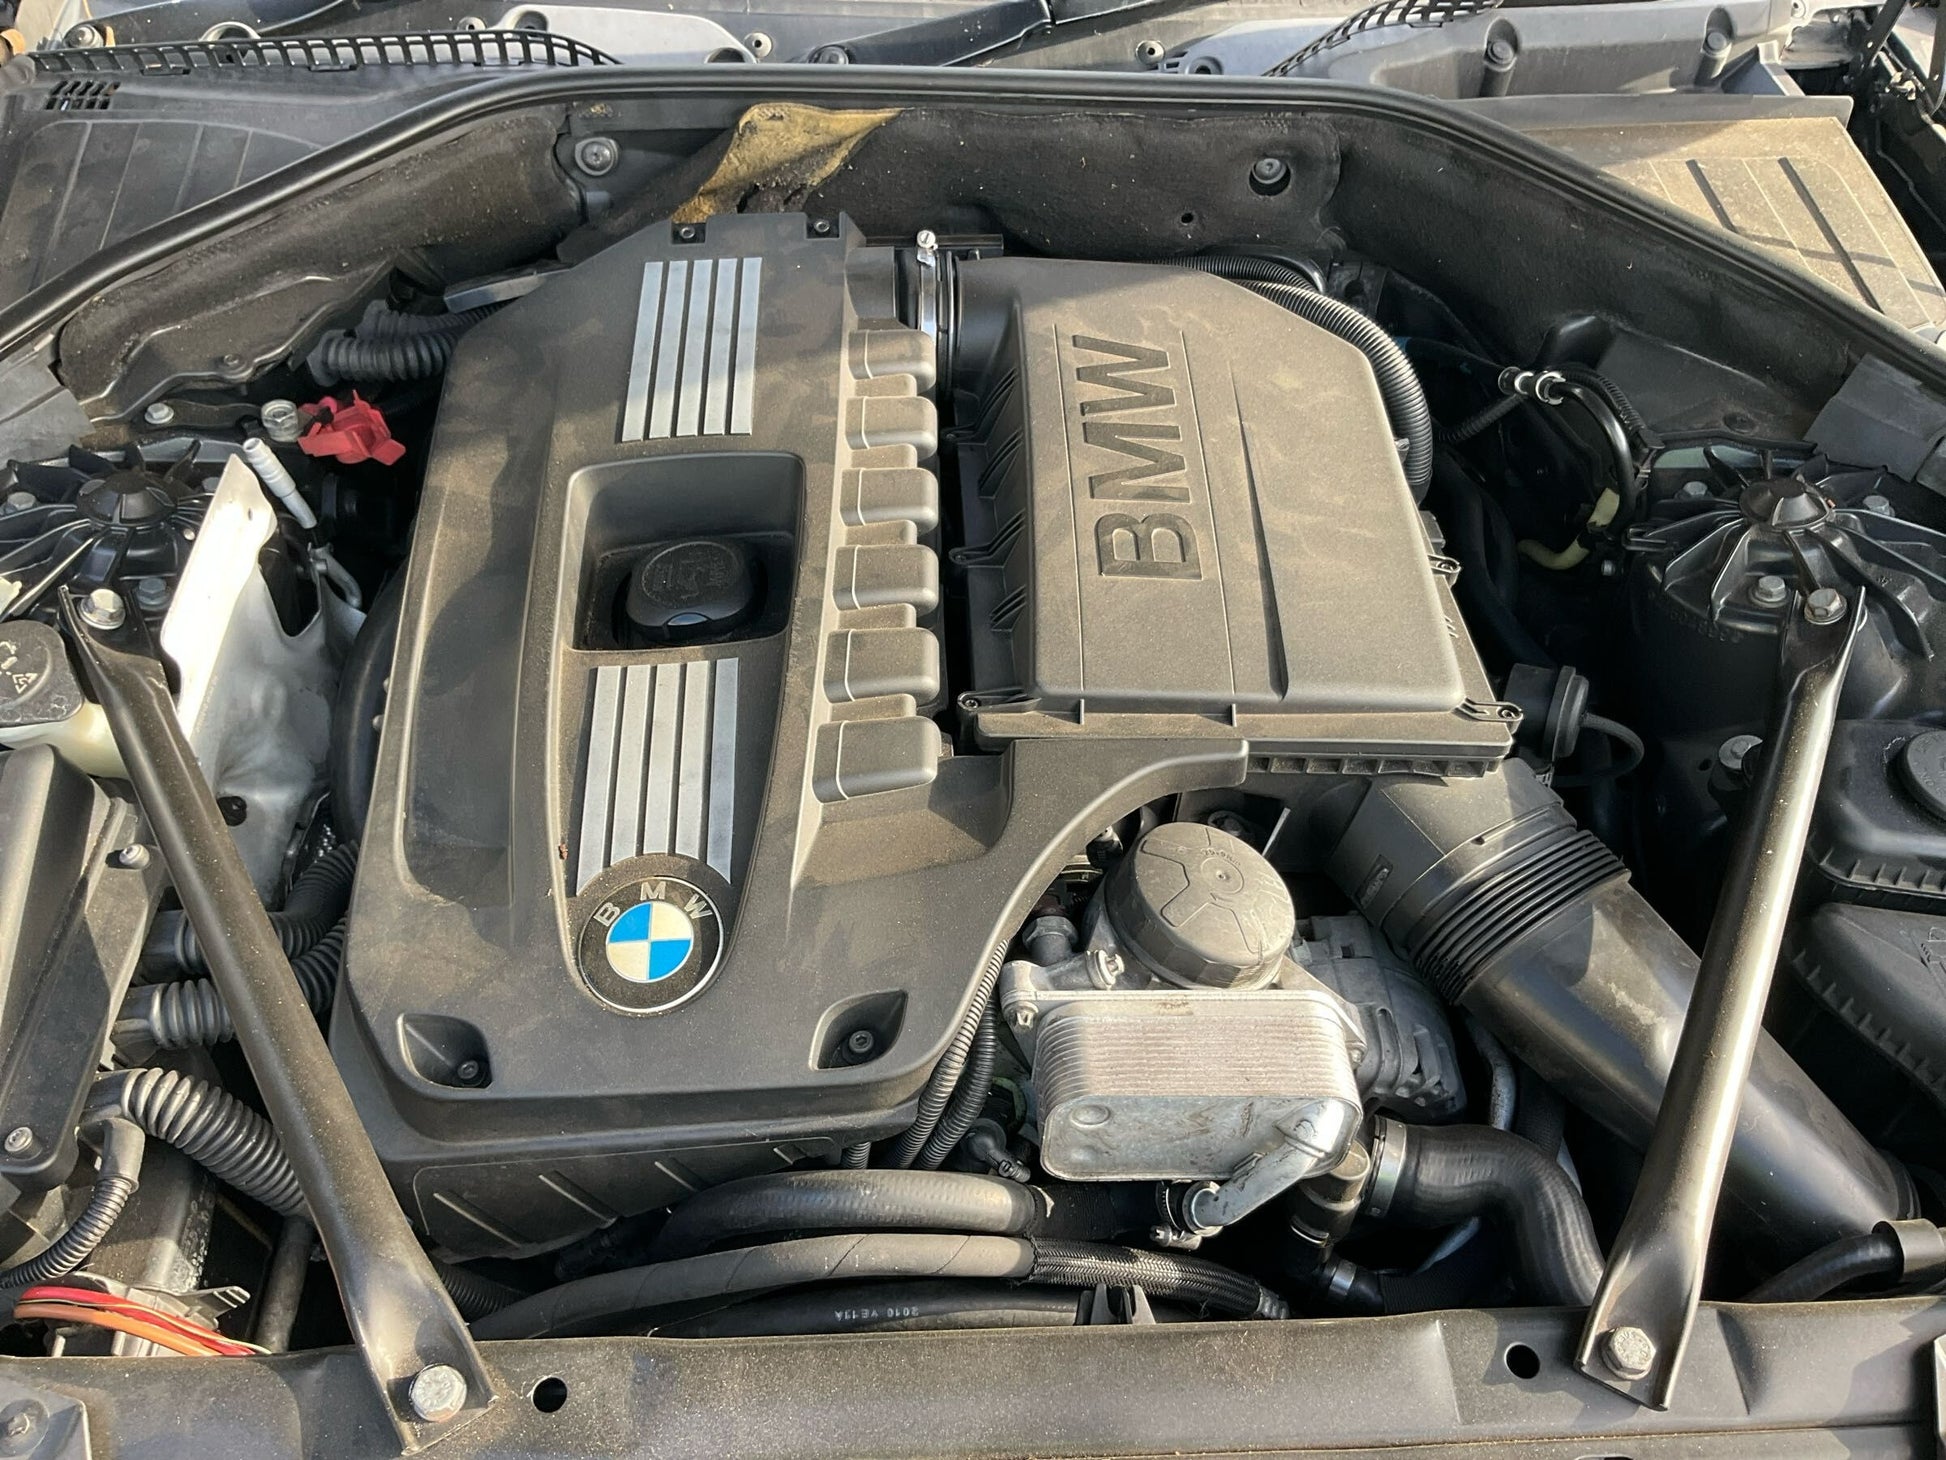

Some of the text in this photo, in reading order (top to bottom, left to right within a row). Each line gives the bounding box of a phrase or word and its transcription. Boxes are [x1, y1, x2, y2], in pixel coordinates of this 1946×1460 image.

[1072, 335, 1203, 580] BMW
[593, 881, 713, 927] BMW
[887, 1306, 919, 1318] 2010
